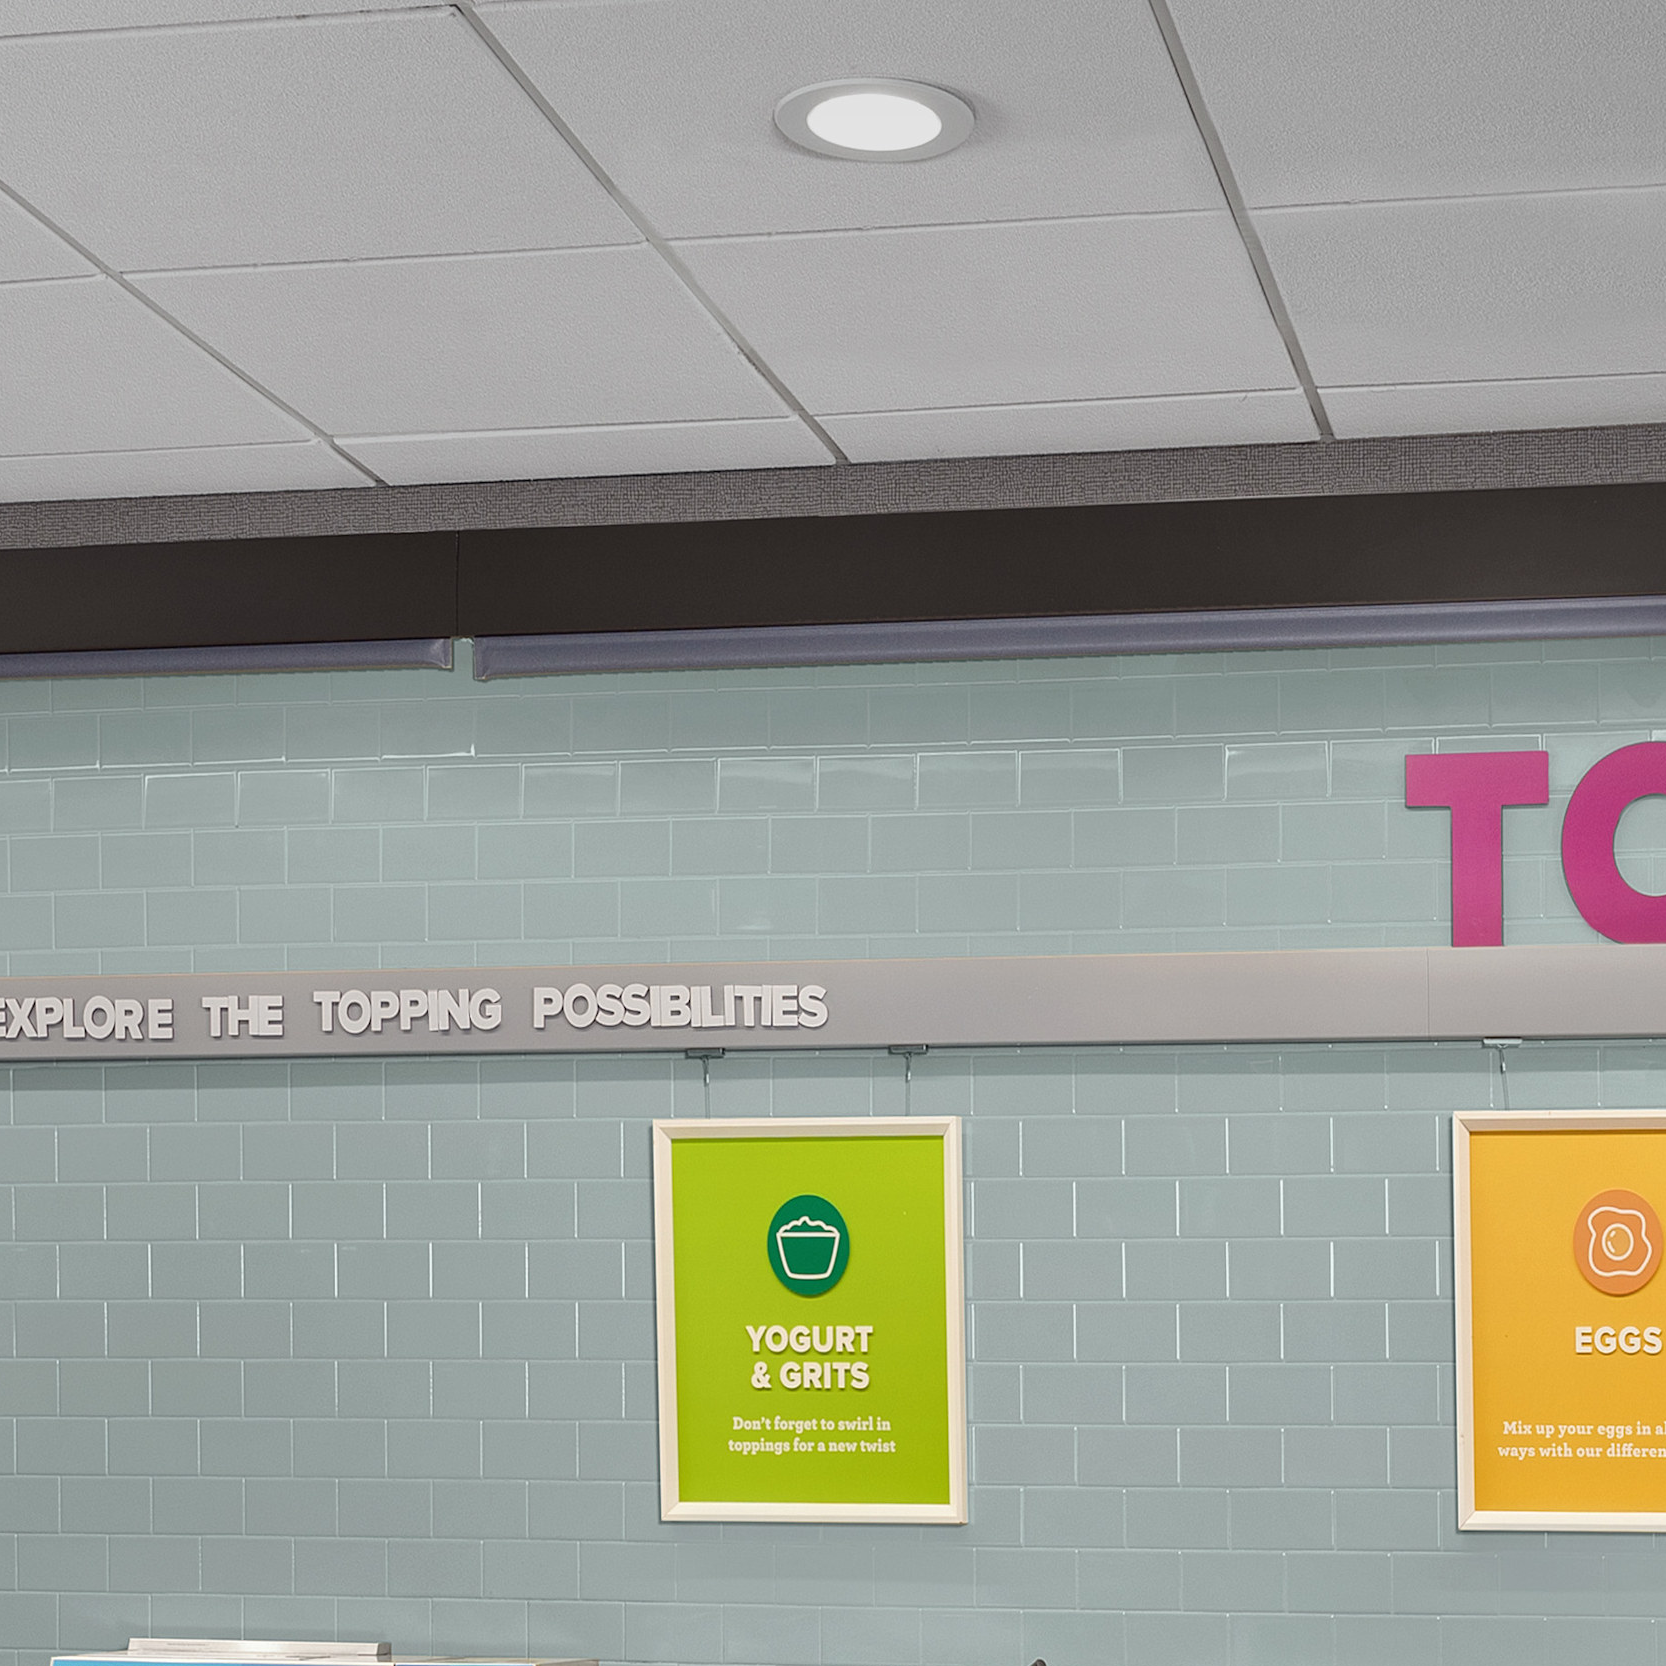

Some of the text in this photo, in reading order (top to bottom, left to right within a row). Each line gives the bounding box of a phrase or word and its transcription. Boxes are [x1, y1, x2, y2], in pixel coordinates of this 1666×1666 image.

[202, 995, 284, 1037] THE
[313, 987, 501, 1035] TOPPING
[534, 983, 829, 1031] POSSIBILITIES
[745, 1325, 874, 1353] YOGURT
[1574, 1326, 1663, 1354] EGGS
[750, 1362, 870, 1389] & GRITS
[774, 1415, 819, 1435] forget
[821, 1418, 836, 1431] to
[838, 1416, 874, 1431] swirl
[876, 1416, 891, 1431] in
[1503, 1420, 1533, 1436] Mix
[1535, 1424, 1556, 1440] up
[1558, 1424, 1594, 1440] your
[1596, 1424, 1633, 1440] eggs
[1636, 1421, 1652, 1436] in
[728, 1438, 896, 1455] toppings for a new twist
[1498, 1446, 1535, 1461] ways
[1538, 1443, 1573, 1458] with
[1576, 1446, 1603, 1458] our
